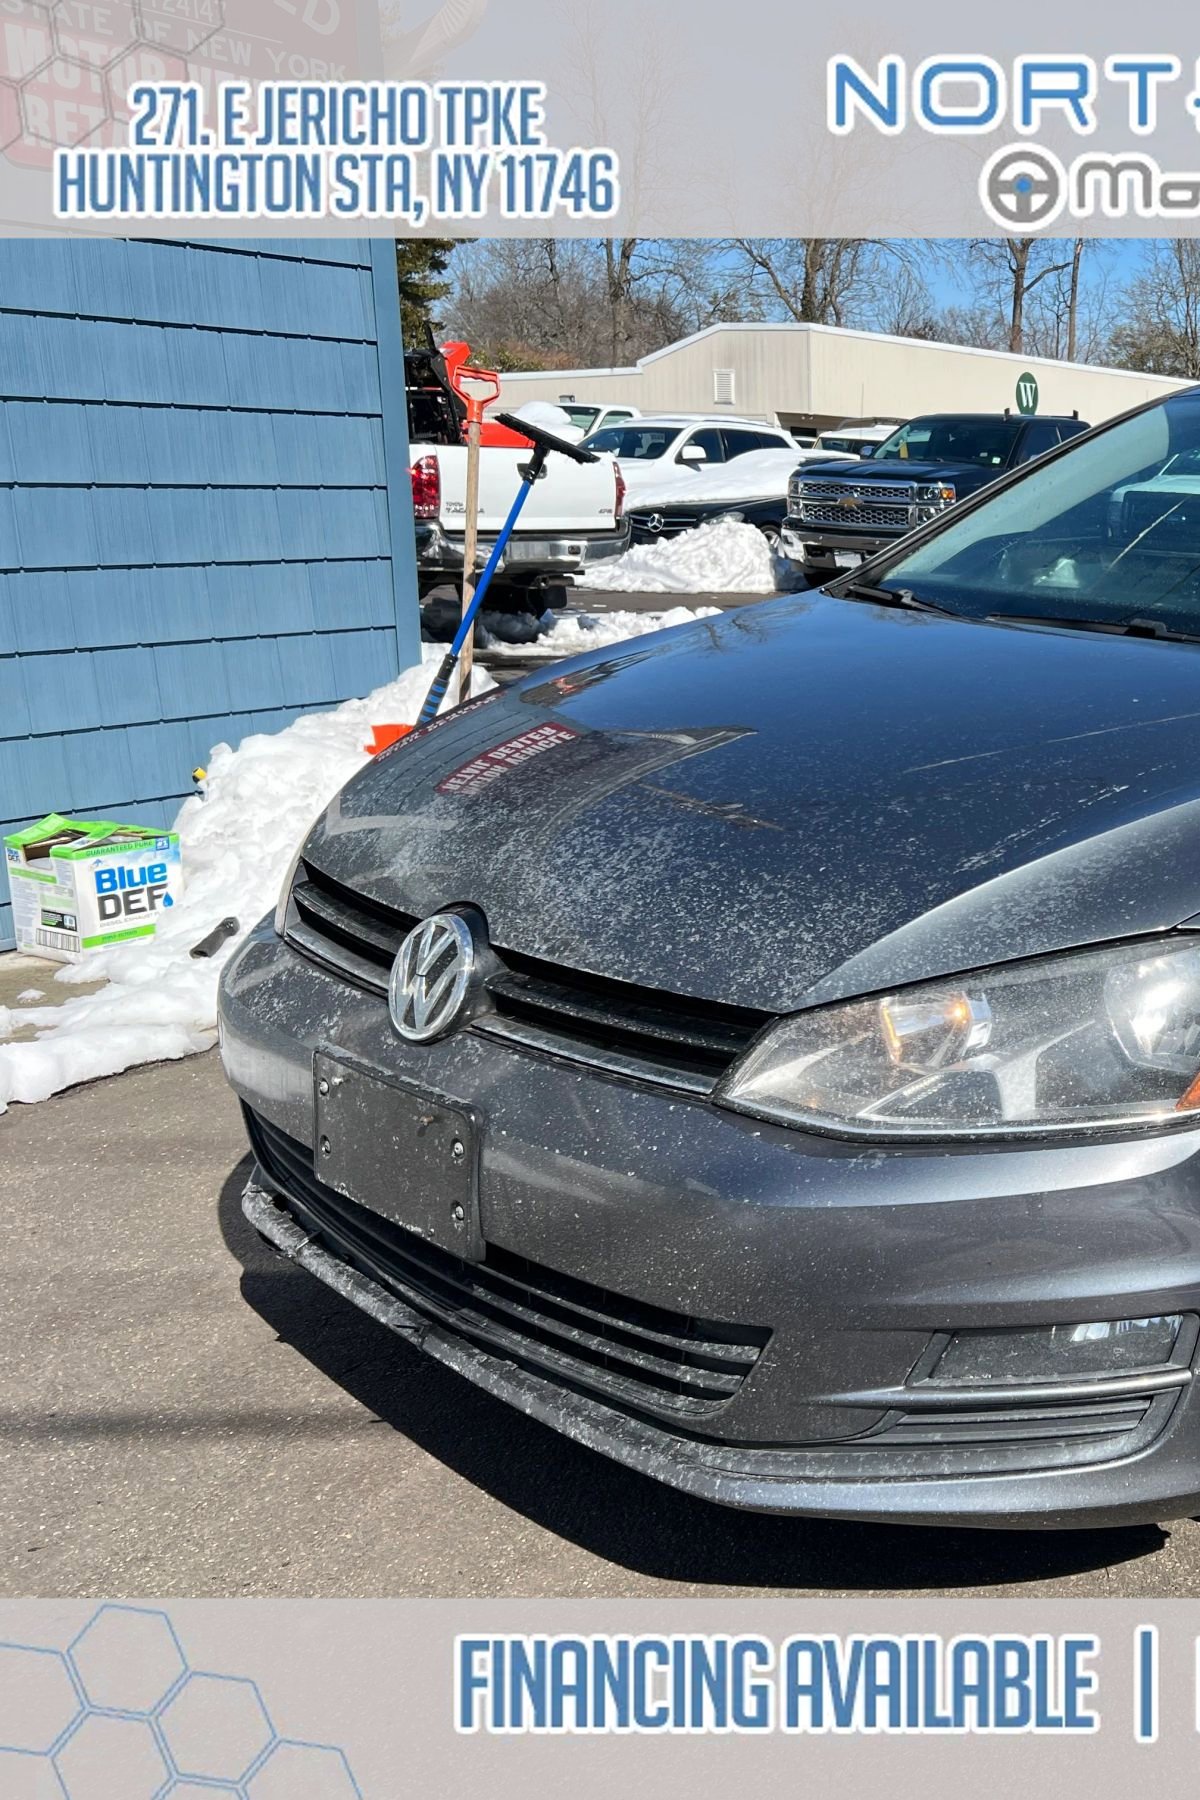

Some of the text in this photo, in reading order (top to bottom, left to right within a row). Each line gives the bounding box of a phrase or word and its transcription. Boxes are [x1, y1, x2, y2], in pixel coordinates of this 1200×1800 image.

[186, 28, 252, 67] NEW
[1018, 382, 1037, 408] W
[94, 862, 168, 894] Blue
[97, 883, 168, 921] DEF
